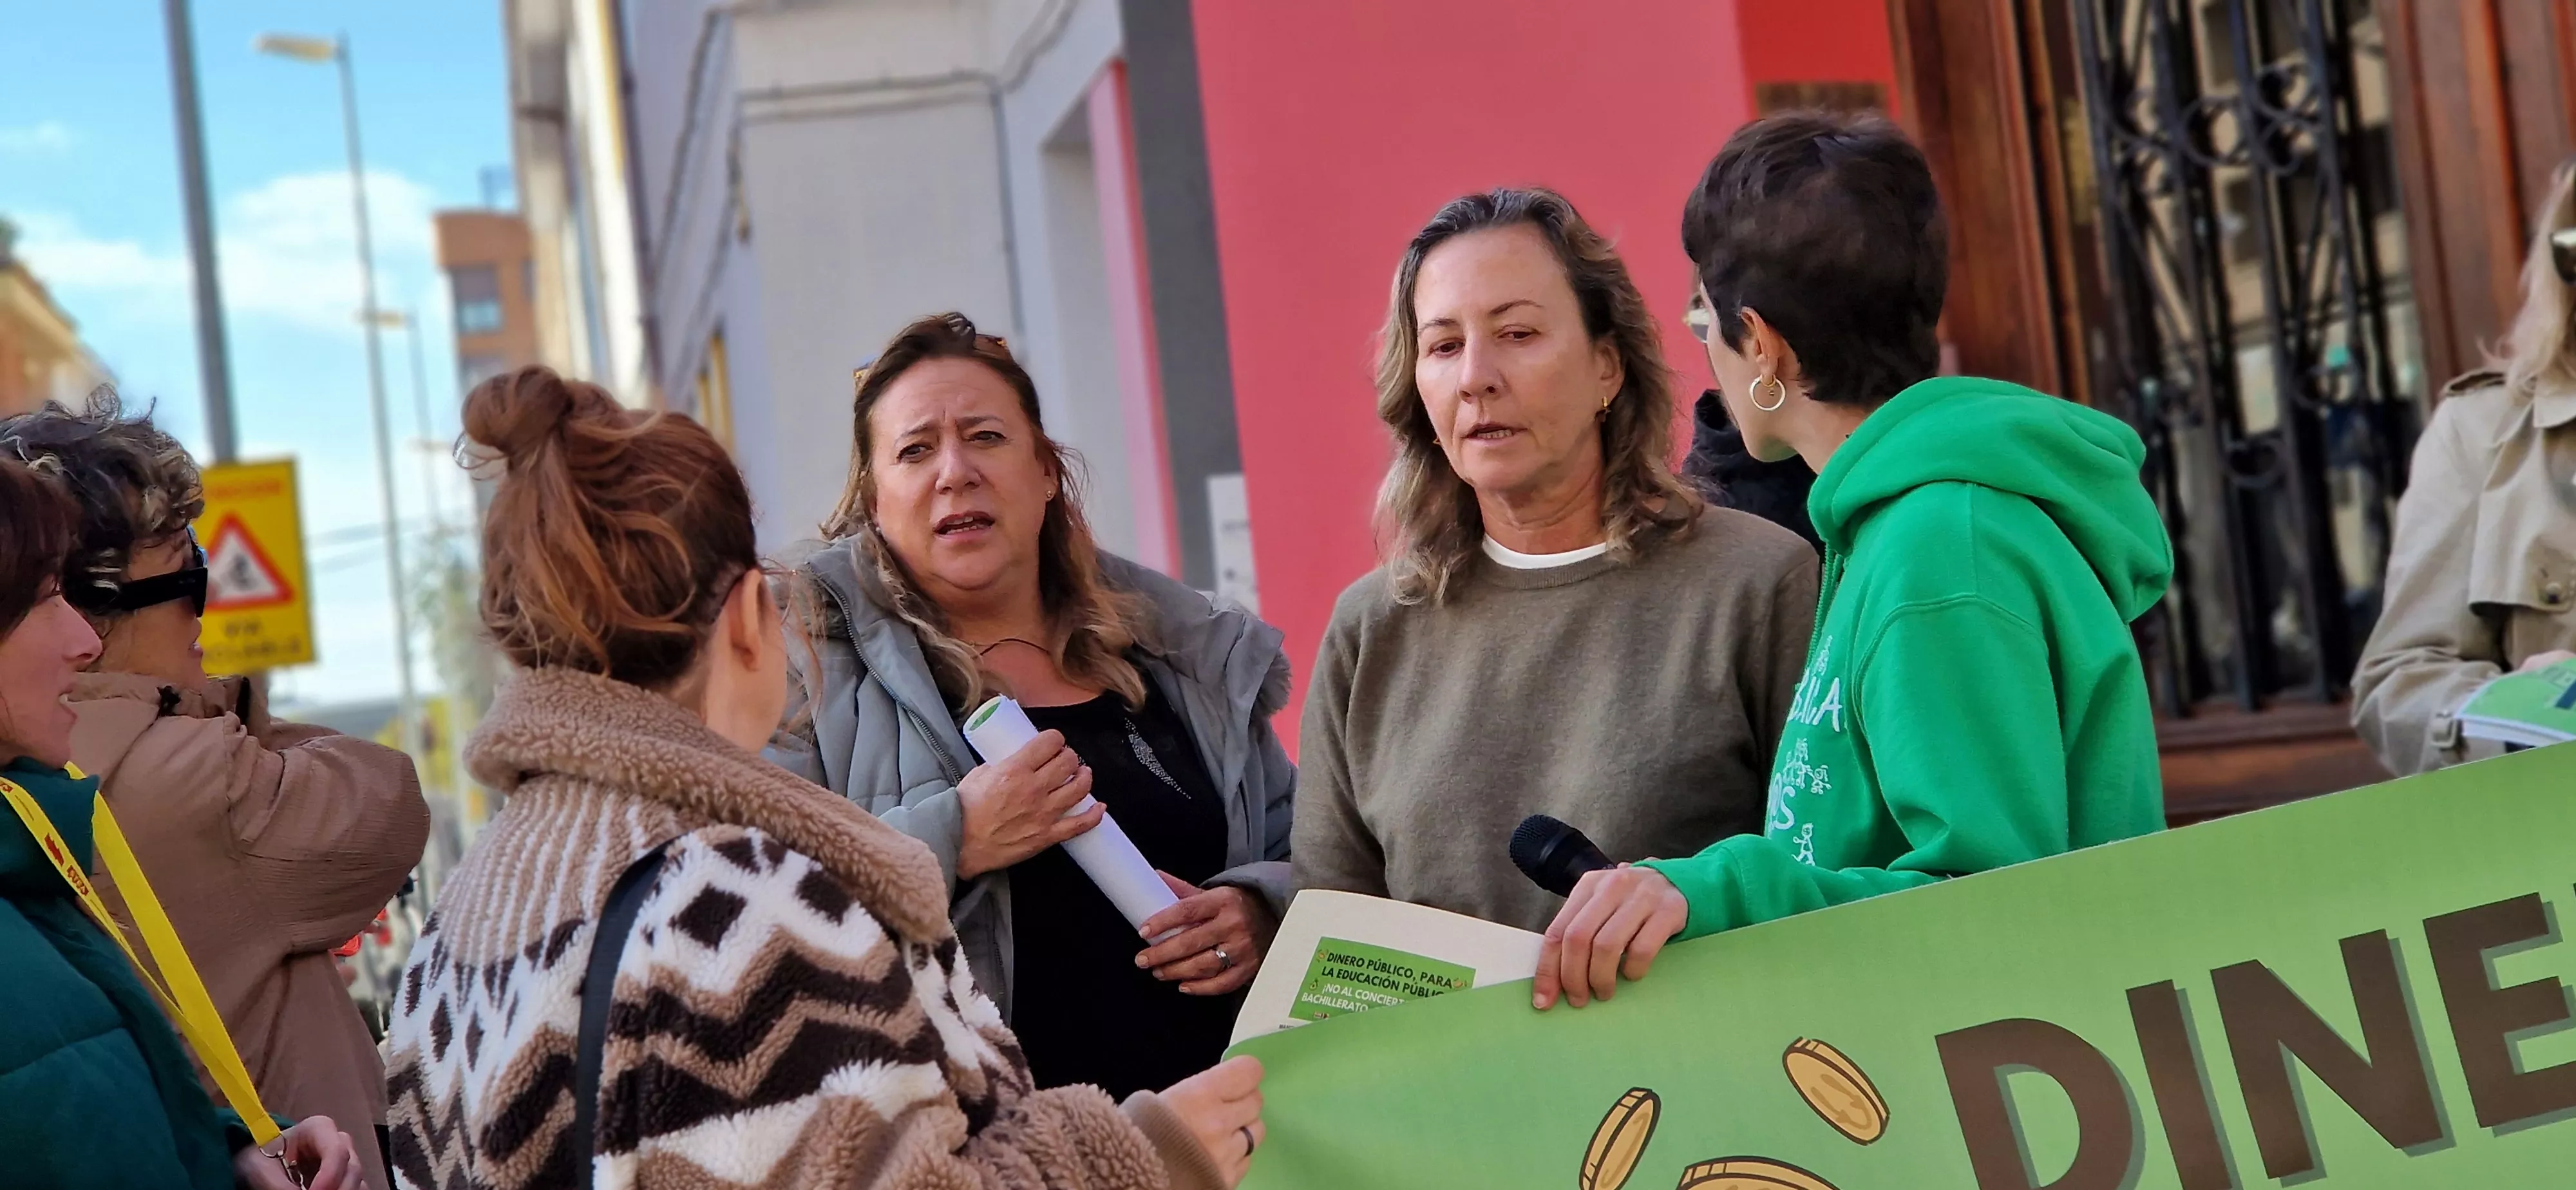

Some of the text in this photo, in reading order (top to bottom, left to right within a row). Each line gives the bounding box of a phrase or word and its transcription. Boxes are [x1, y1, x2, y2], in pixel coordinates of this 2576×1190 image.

[1321, 966, 1334, 978] LA
[1336, 969, 1400, 992] EDUCACIÓN
[1327, 952, 1452, 989] DINERO PÚBLICO, PARA
[1302, 992, 1368, 1013] BACHILLERATO
[1322, 983, 1340, 994] ¡NO
[1341, 987, 1352, 997] AL
[1935, 882, 2576, 1190] DINE
